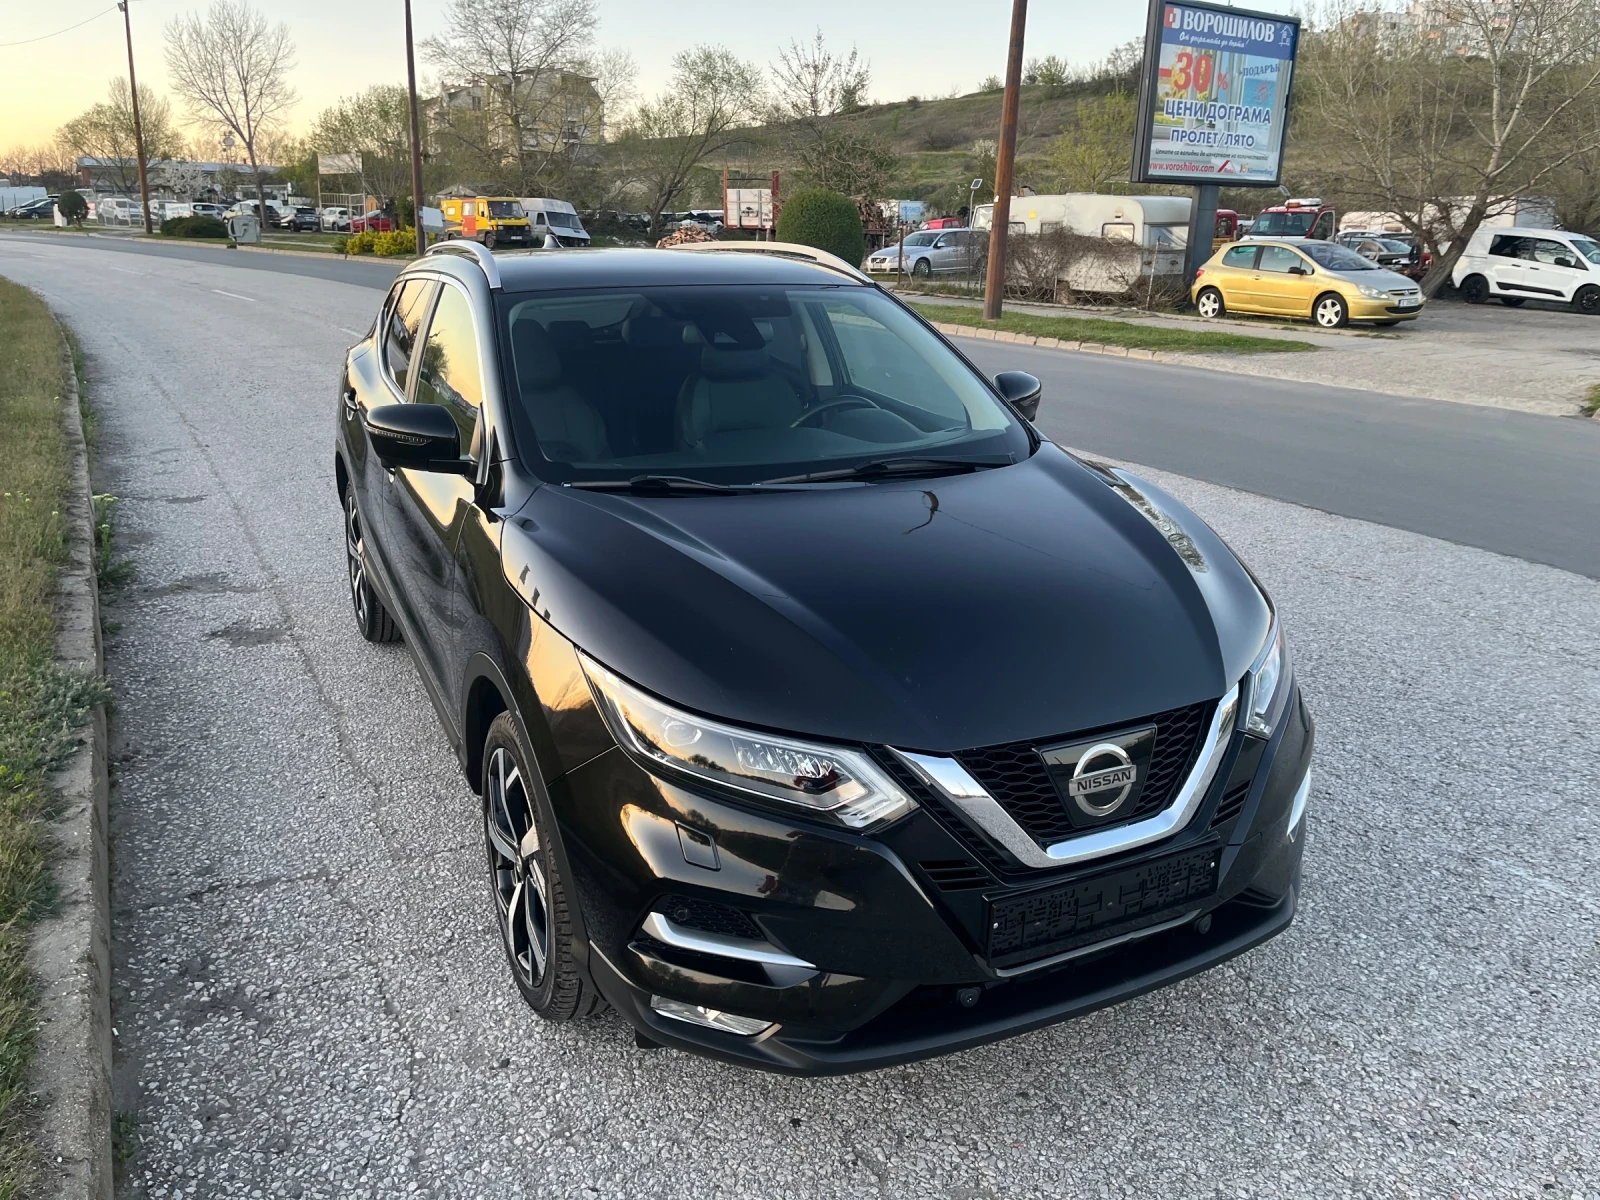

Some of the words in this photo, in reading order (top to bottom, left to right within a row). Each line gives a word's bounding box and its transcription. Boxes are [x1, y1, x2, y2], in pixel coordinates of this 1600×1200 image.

[1183, 10, 1275, 43] ВОРОШИЛОВ
[1165, 99, 1204, 119] ЦЕНИ
[1206, 103, 1271, 124] ДОГРАМА
[1077, 770, 1131, 791] NISSAN
